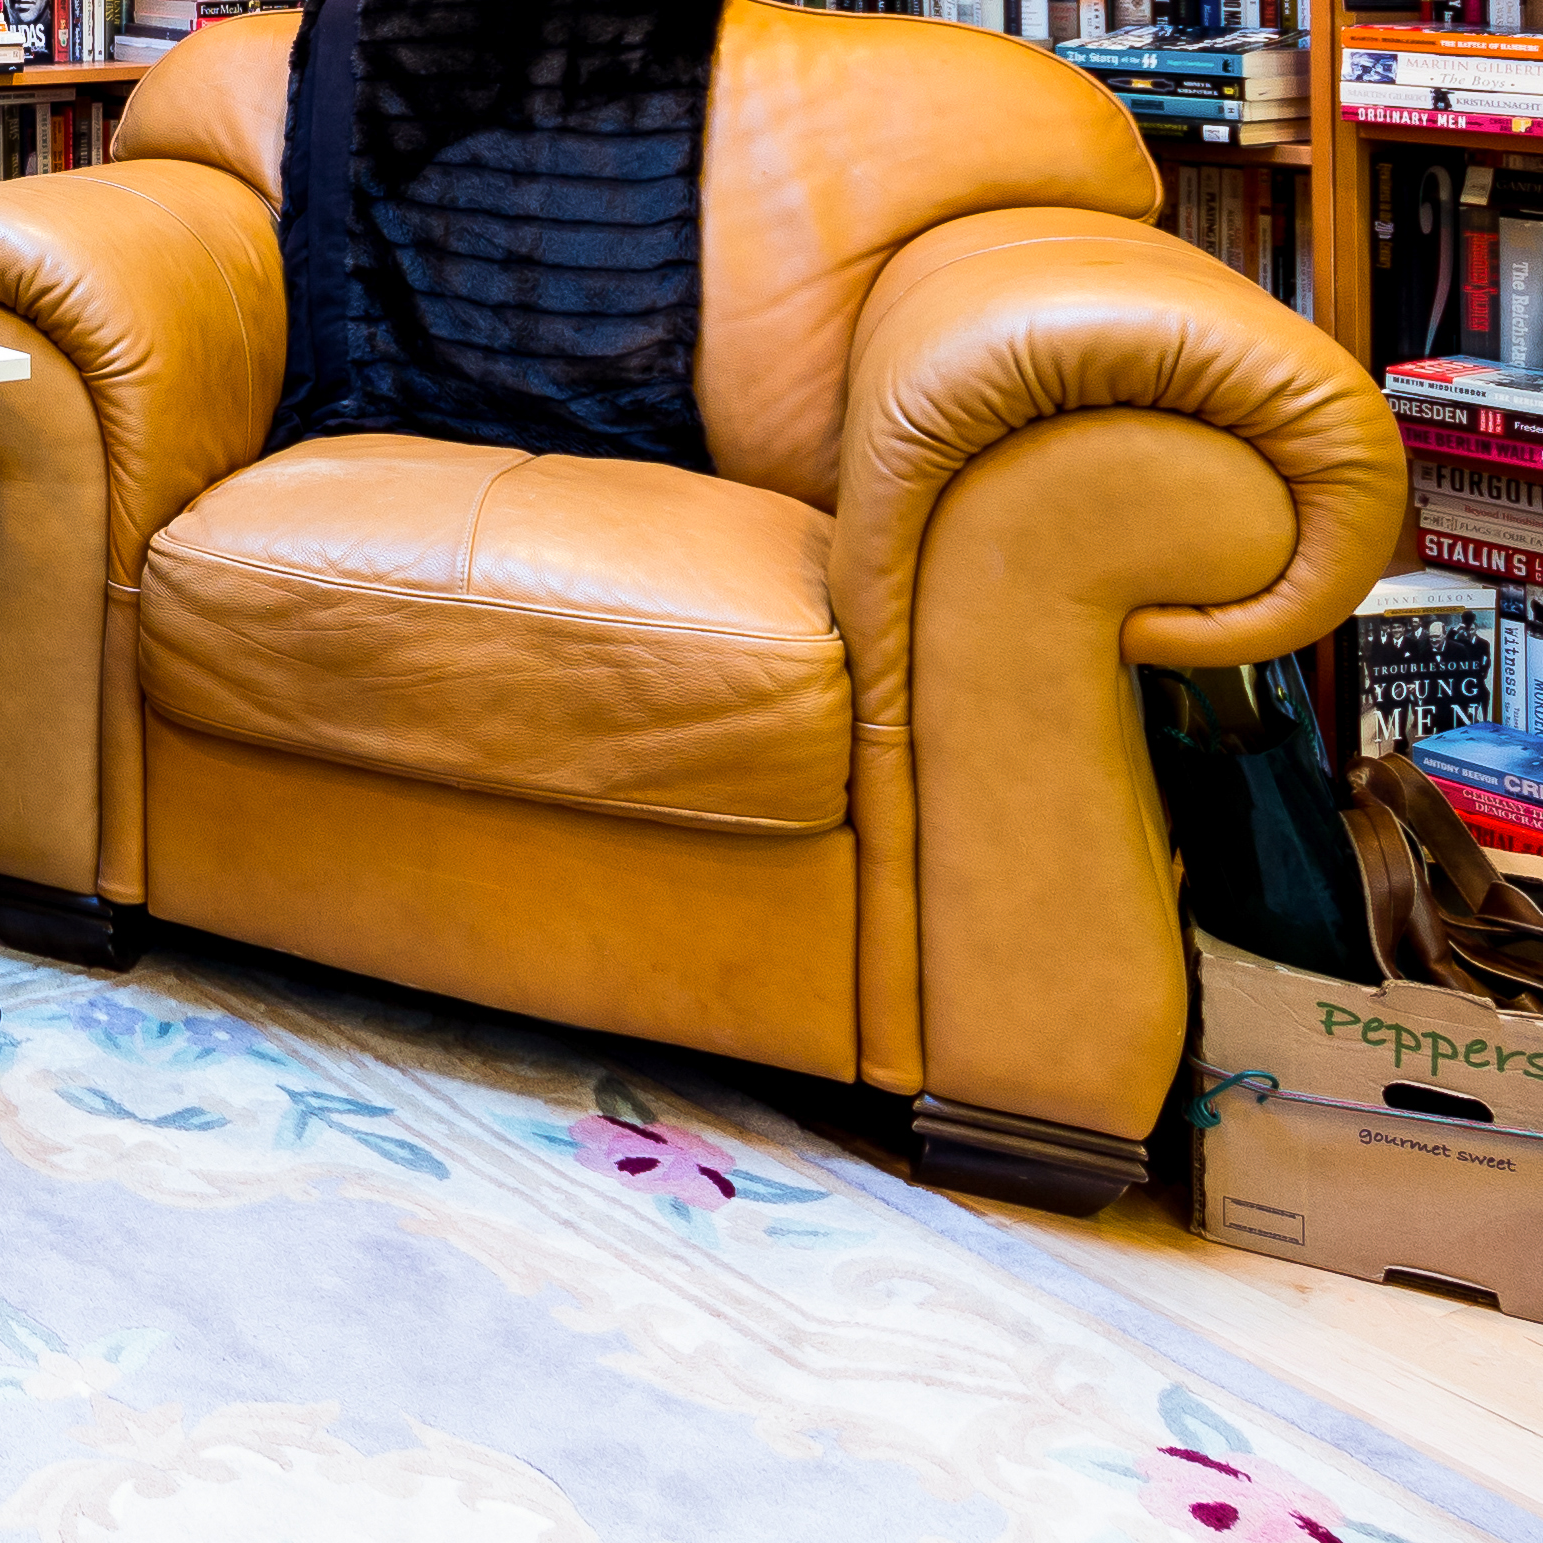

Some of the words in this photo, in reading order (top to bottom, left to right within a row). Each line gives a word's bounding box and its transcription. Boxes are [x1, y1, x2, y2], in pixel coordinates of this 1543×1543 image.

[1358, 108, 1430, 125] ORDINARY
[1437, 114, 1467, 129] MEN
[1425, 534, 1527, 576] STALIN'S
[1373, 660, 1480, 676] TROUBLESOME
[1373, 677, 1479, 703] YOUNG
[1373, 703, 1479, 743] MEN
[1316, 1001, 1543, 1081] Peppers
[1359, 1127, 1452, 1158] gourmet
[1457, 1150, 1517, 1172] sweet
